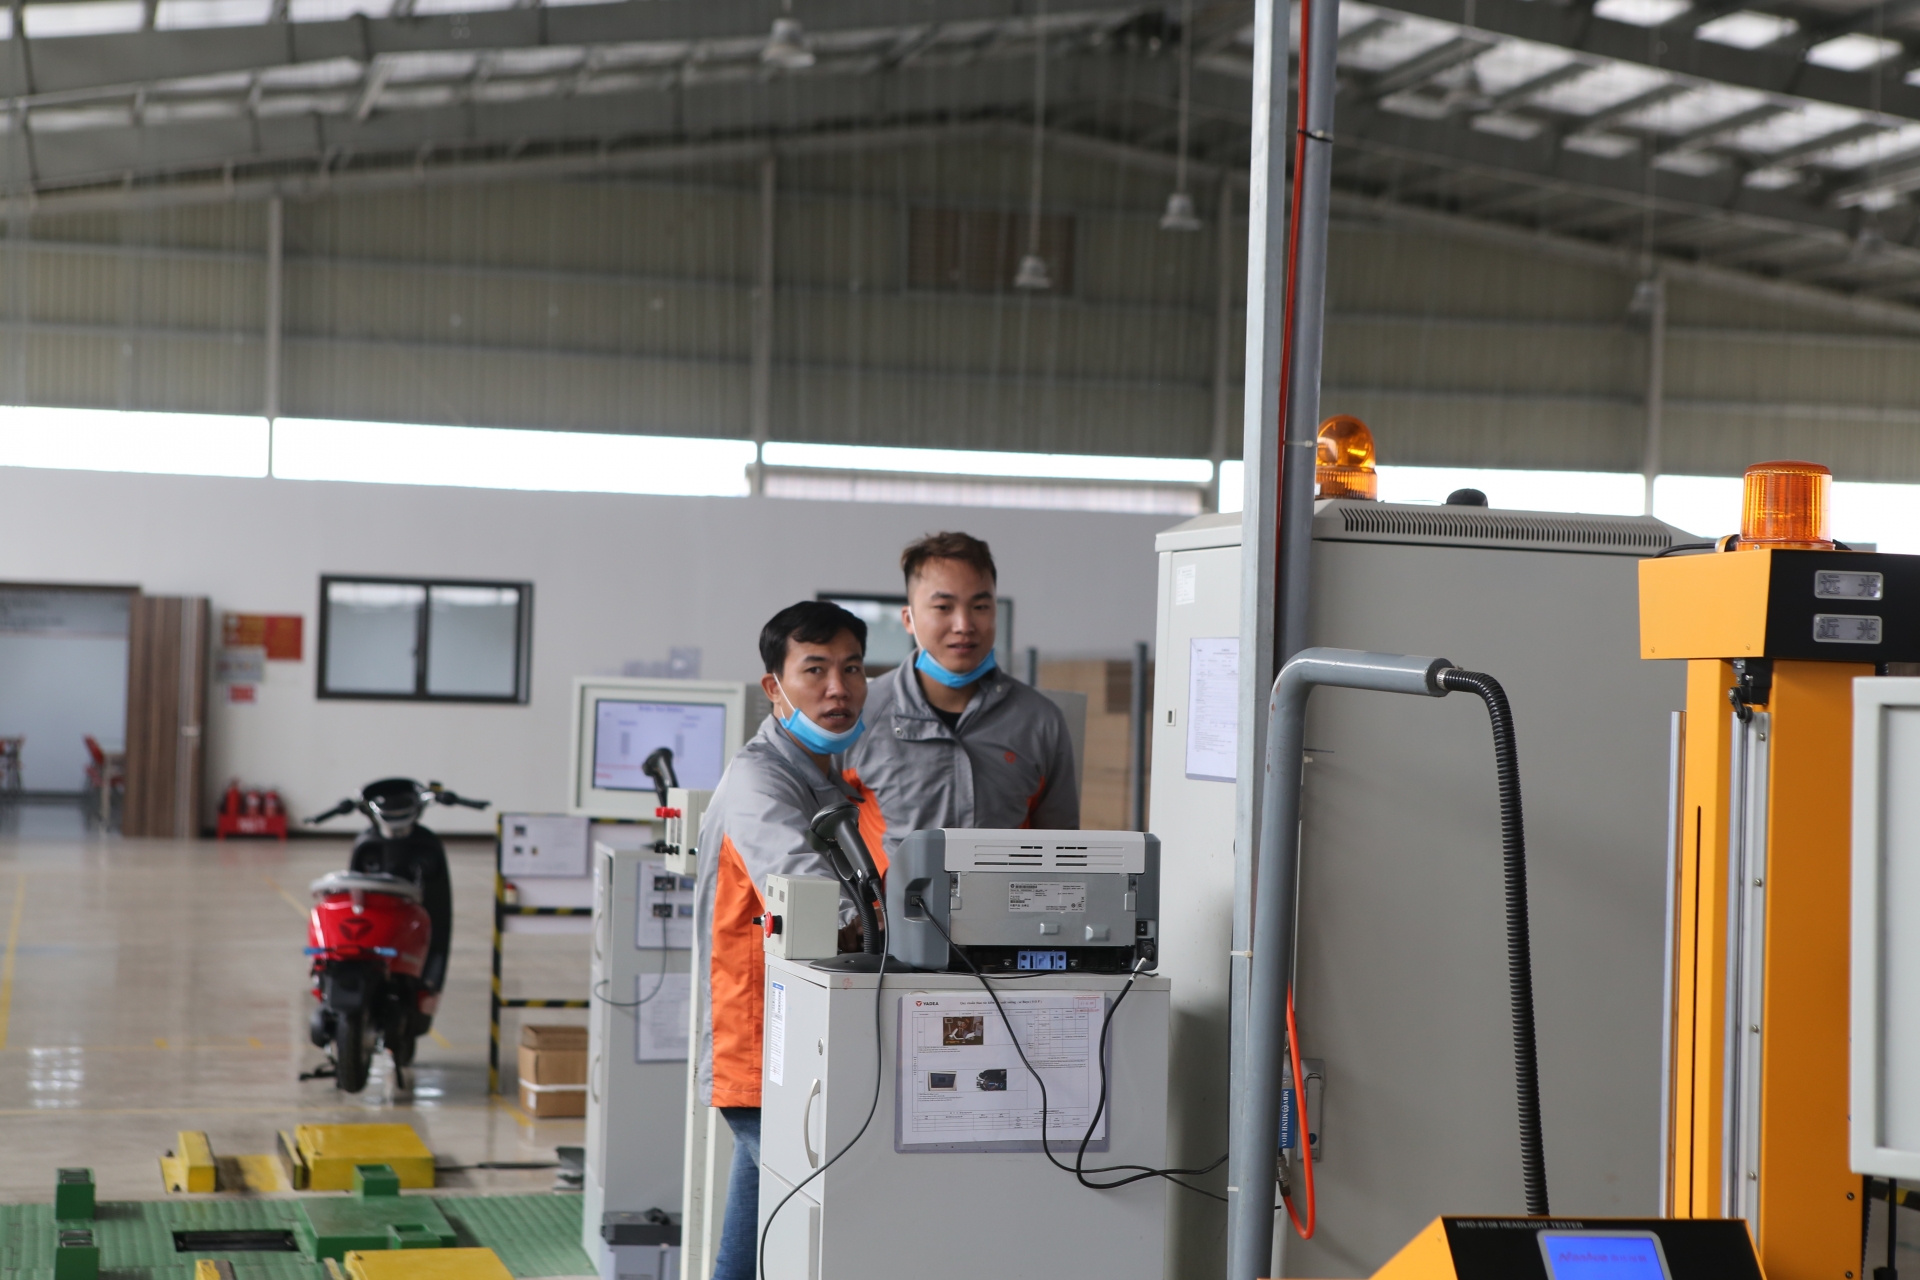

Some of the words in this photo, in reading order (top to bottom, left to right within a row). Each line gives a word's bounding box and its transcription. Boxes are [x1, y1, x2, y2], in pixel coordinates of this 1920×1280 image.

[1820, 575, 1877, 597] 远光
[1819, 618, 1877, 640] 近光
[1499, 1220, 1549, 1229] HEADLIGHT
[1550, 1221, 1584, 1230] TESTER
